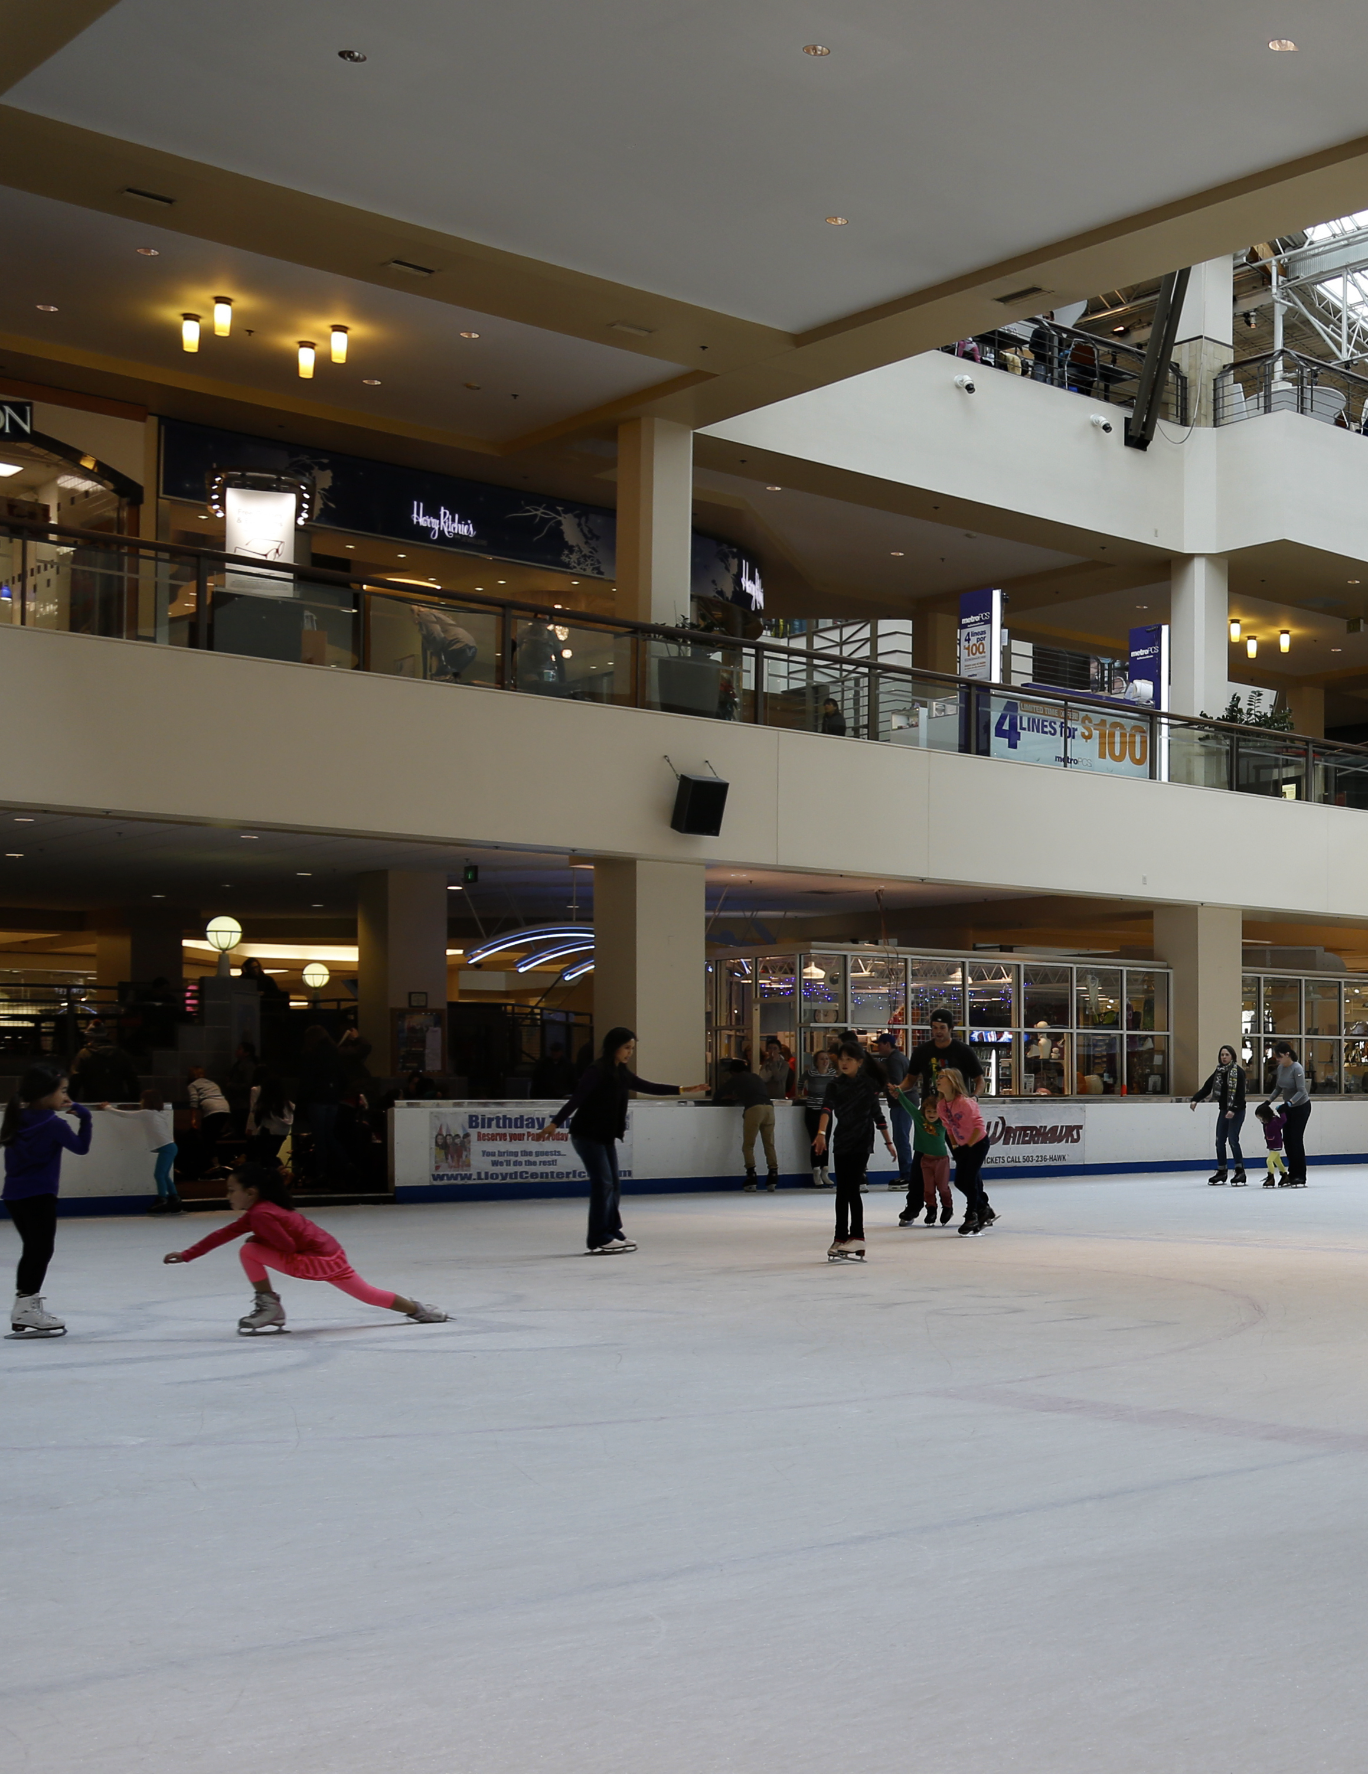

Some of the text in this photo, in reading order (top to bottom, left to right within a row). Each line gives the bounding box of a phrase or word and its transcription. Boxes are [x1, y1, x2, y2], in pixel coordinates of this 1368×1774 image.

[0, 405, 31, 434] N
[411, 501, 477, 540] Harry Ritchie's
[961, 611, 991, 624] metroPCS
[964, 631, 971, 645] 4
[1130, 645, 1160, 658] metroPCS
[1020, 701, 1044, 715] LIMITED
[1044, 706, 1059, 717] TIME
[994, 701, 1078, 750] 4 LINES for
[1080, 714, 1148, 766] $100
[468, 1114, 546, 1132] Birthday
[477, 1131, 508, 1142] Reserve
[508, 1133, 525, 1143] your
[526, 1131, 546, 1142] Pay
[497, 1149, 519, 1159] bring
[520, 1149, 533, 1157] the
[983, 1154, 1067, 1165] ICKETS CALL 503-236-HAWK
[491, 1159, 558, 1167] We'll do the rest!
